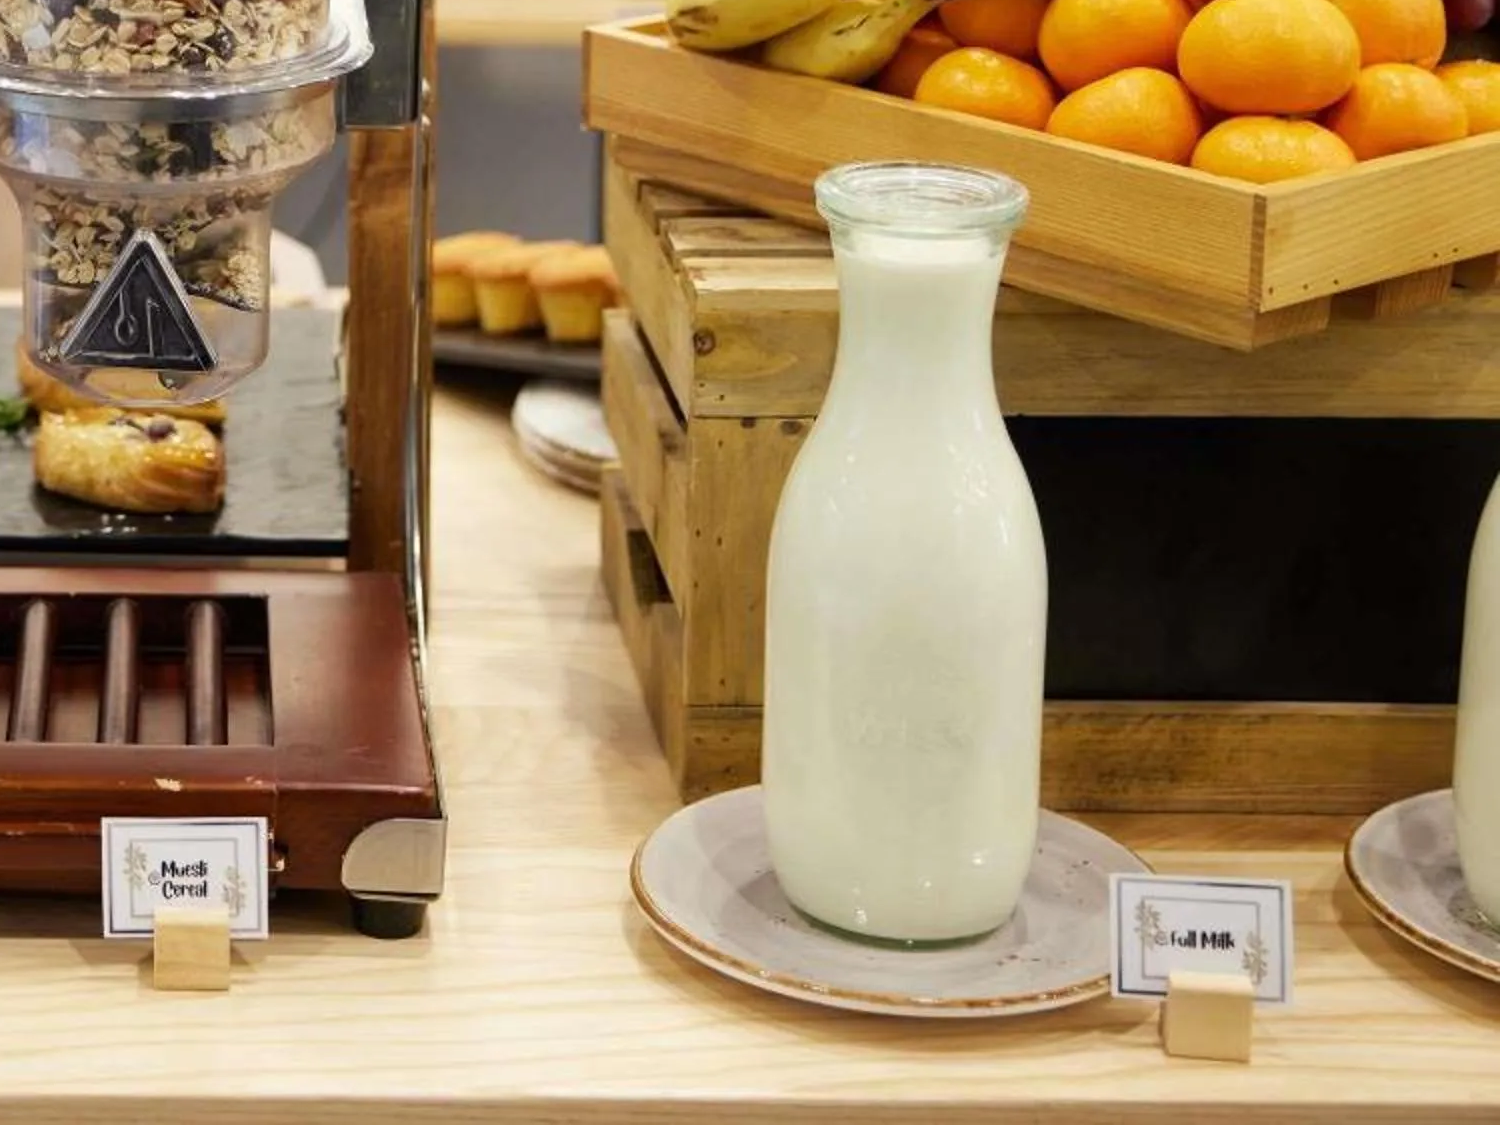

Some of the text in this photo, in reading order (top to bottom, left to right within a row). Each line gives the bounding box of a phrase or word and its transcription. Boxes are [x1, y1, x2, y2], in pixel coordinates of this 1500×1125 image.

[161, 860, 208, 878] Muesli
[162, 880, 208, 899] Cereal
[1170, 929, 1236, 950] Full Milk
